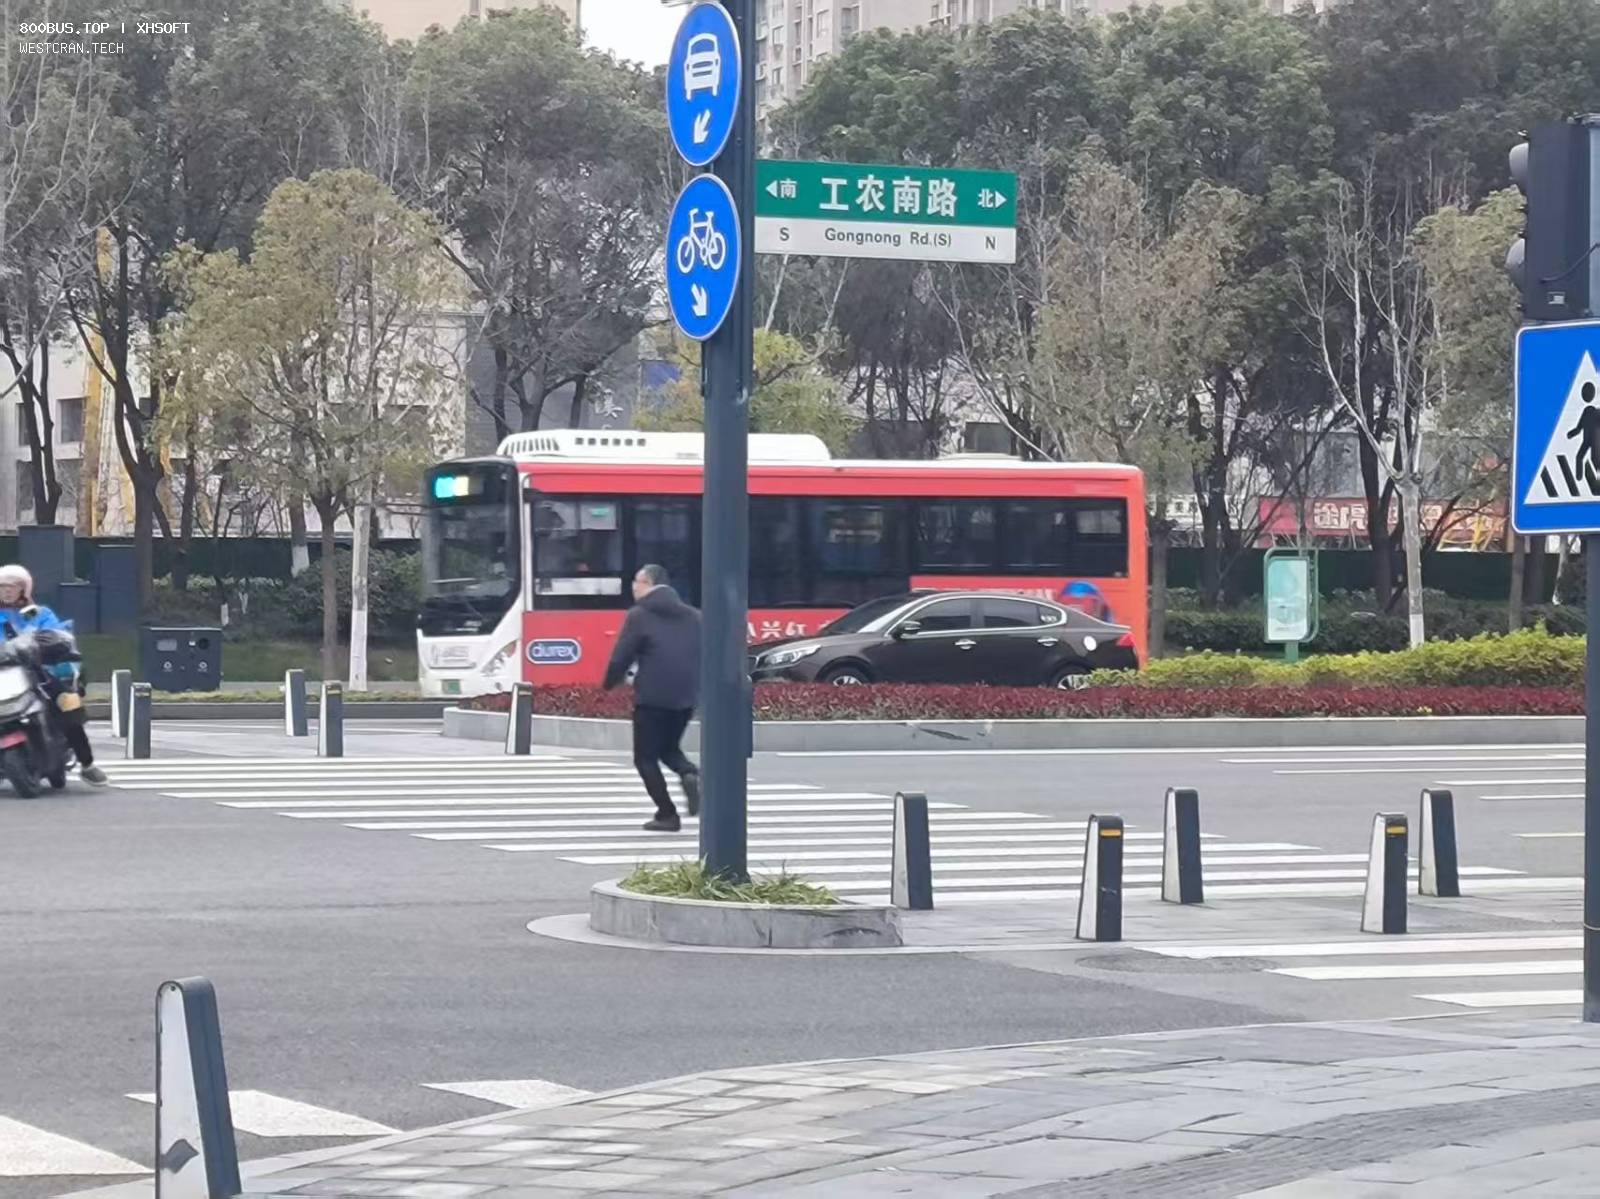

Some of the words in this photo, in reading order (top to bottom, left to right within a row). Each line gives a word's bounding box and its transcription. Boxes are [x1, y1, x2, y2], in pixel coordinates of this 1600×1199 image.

[780, 178, 798, 199] 南
[819, 174, 958, 217] 工农南路
[977, 188, 995, 209] 北
[779, 227, 789, 241] S
[824, 228, 901, 246] Gongnong
[910, 231, 952, 248] Rd.(S)
[985, 236, 996, 250] N
[531, 643, 576, 660] durex
